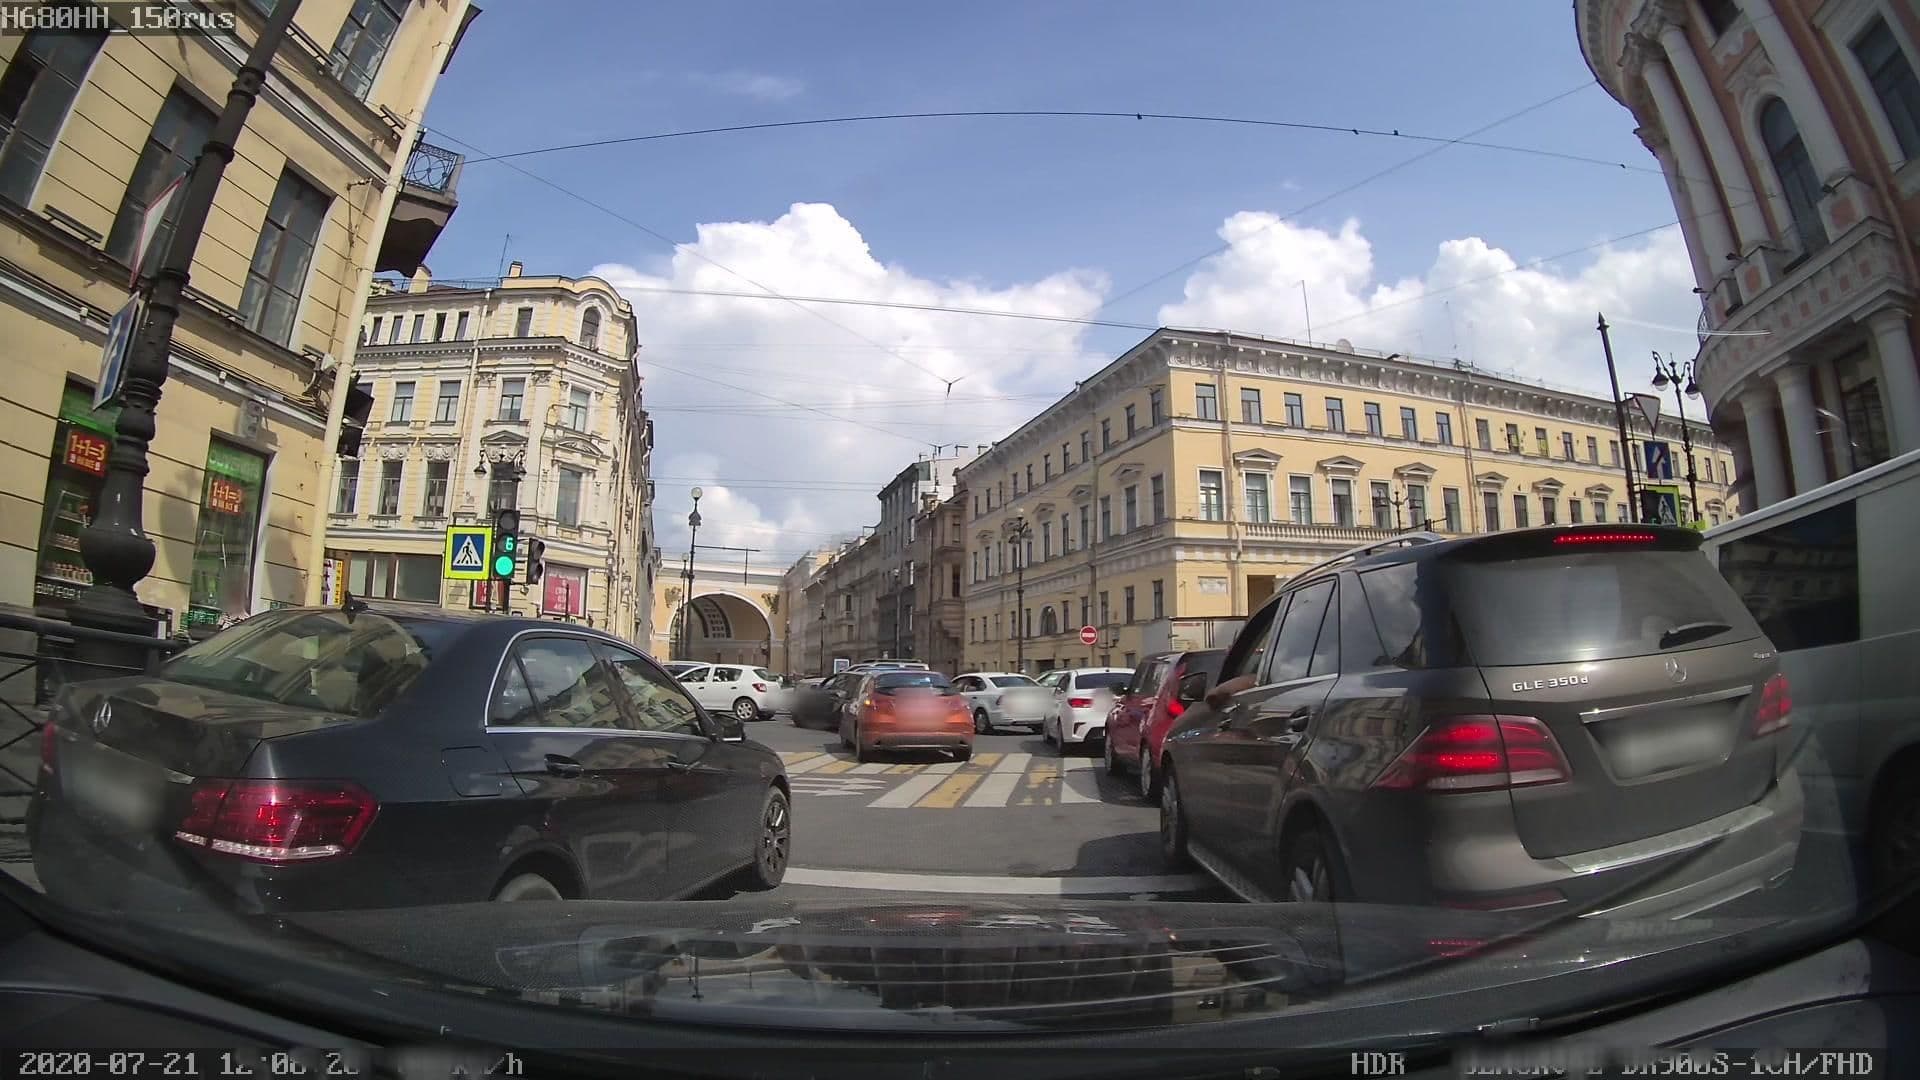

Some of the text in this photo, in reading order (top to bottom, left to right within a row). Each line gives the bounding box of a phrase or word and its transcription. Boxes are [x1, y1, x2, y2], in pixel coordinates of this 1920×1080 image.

[71, 434, 105, 460] 1+1=3
[505, 537, 514, 551] 6
[1512, 680, 1544, 692] GLE
